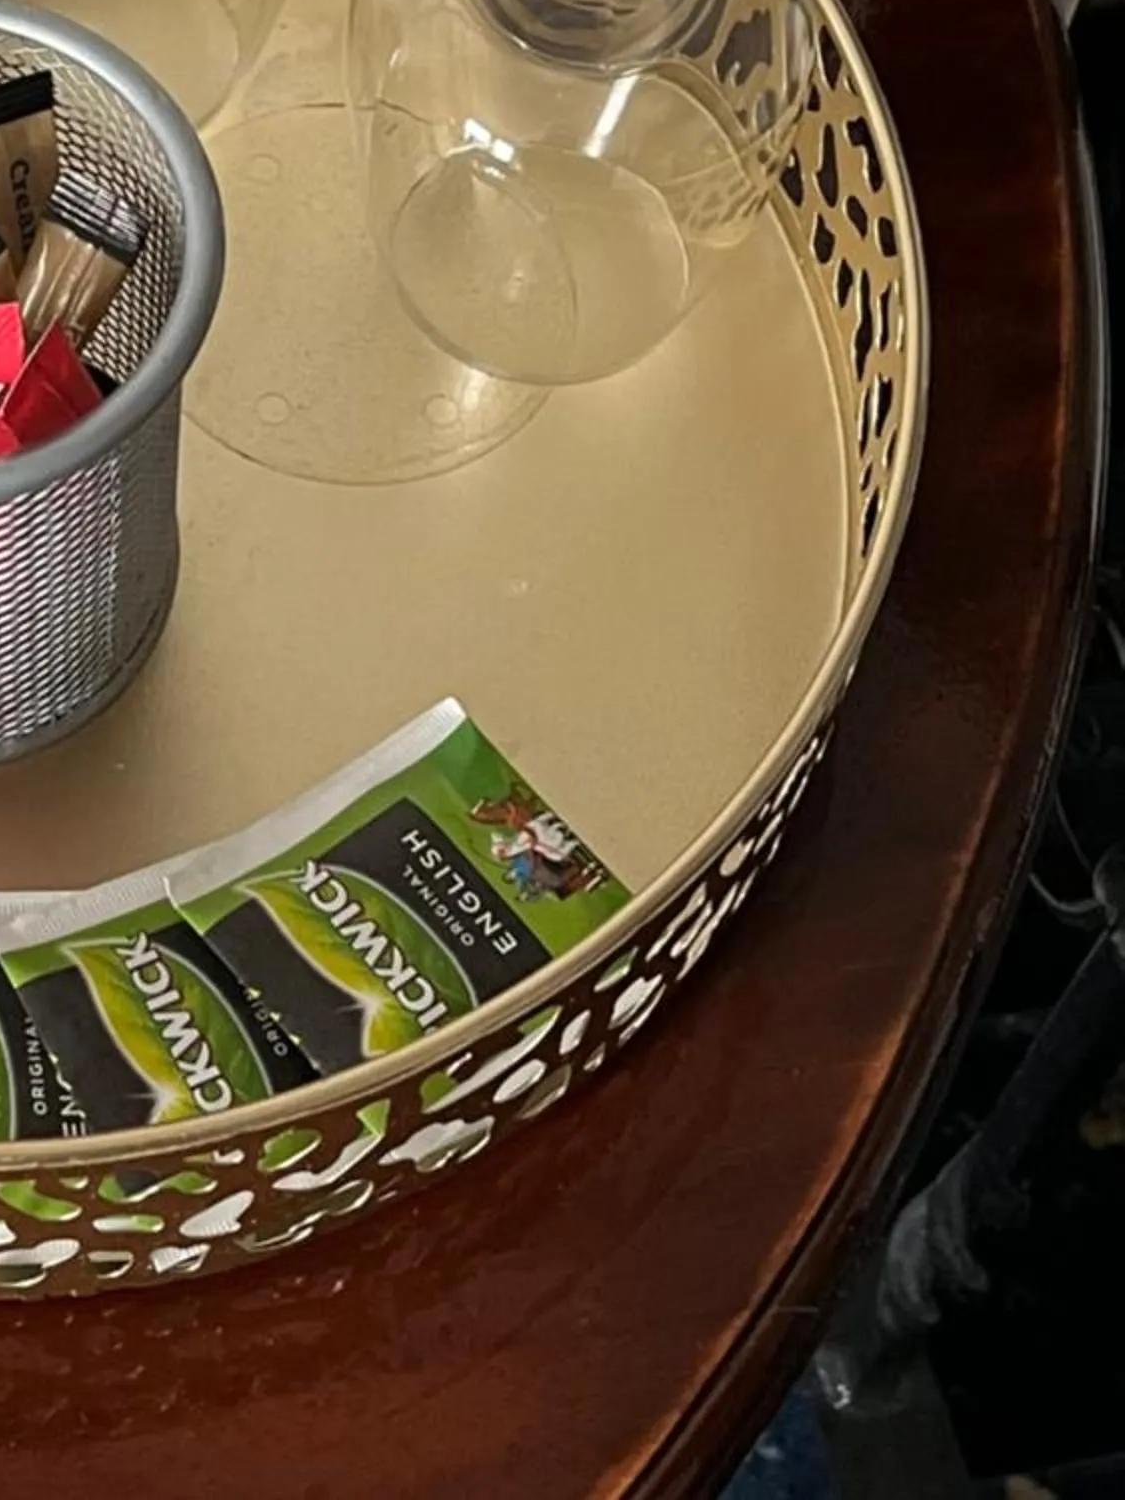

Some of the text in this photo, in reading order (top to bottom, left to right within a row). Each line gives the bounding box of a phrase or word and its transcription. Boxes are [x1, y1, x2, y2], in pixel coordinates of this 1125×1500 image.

[288, 860, 449, 1031] ICKWICK
[401, 829, 518, 955] ENGLISH
[402, 863, 475, 947] ORIGINAL
[115, 931, 233, 1113] CKWICK
